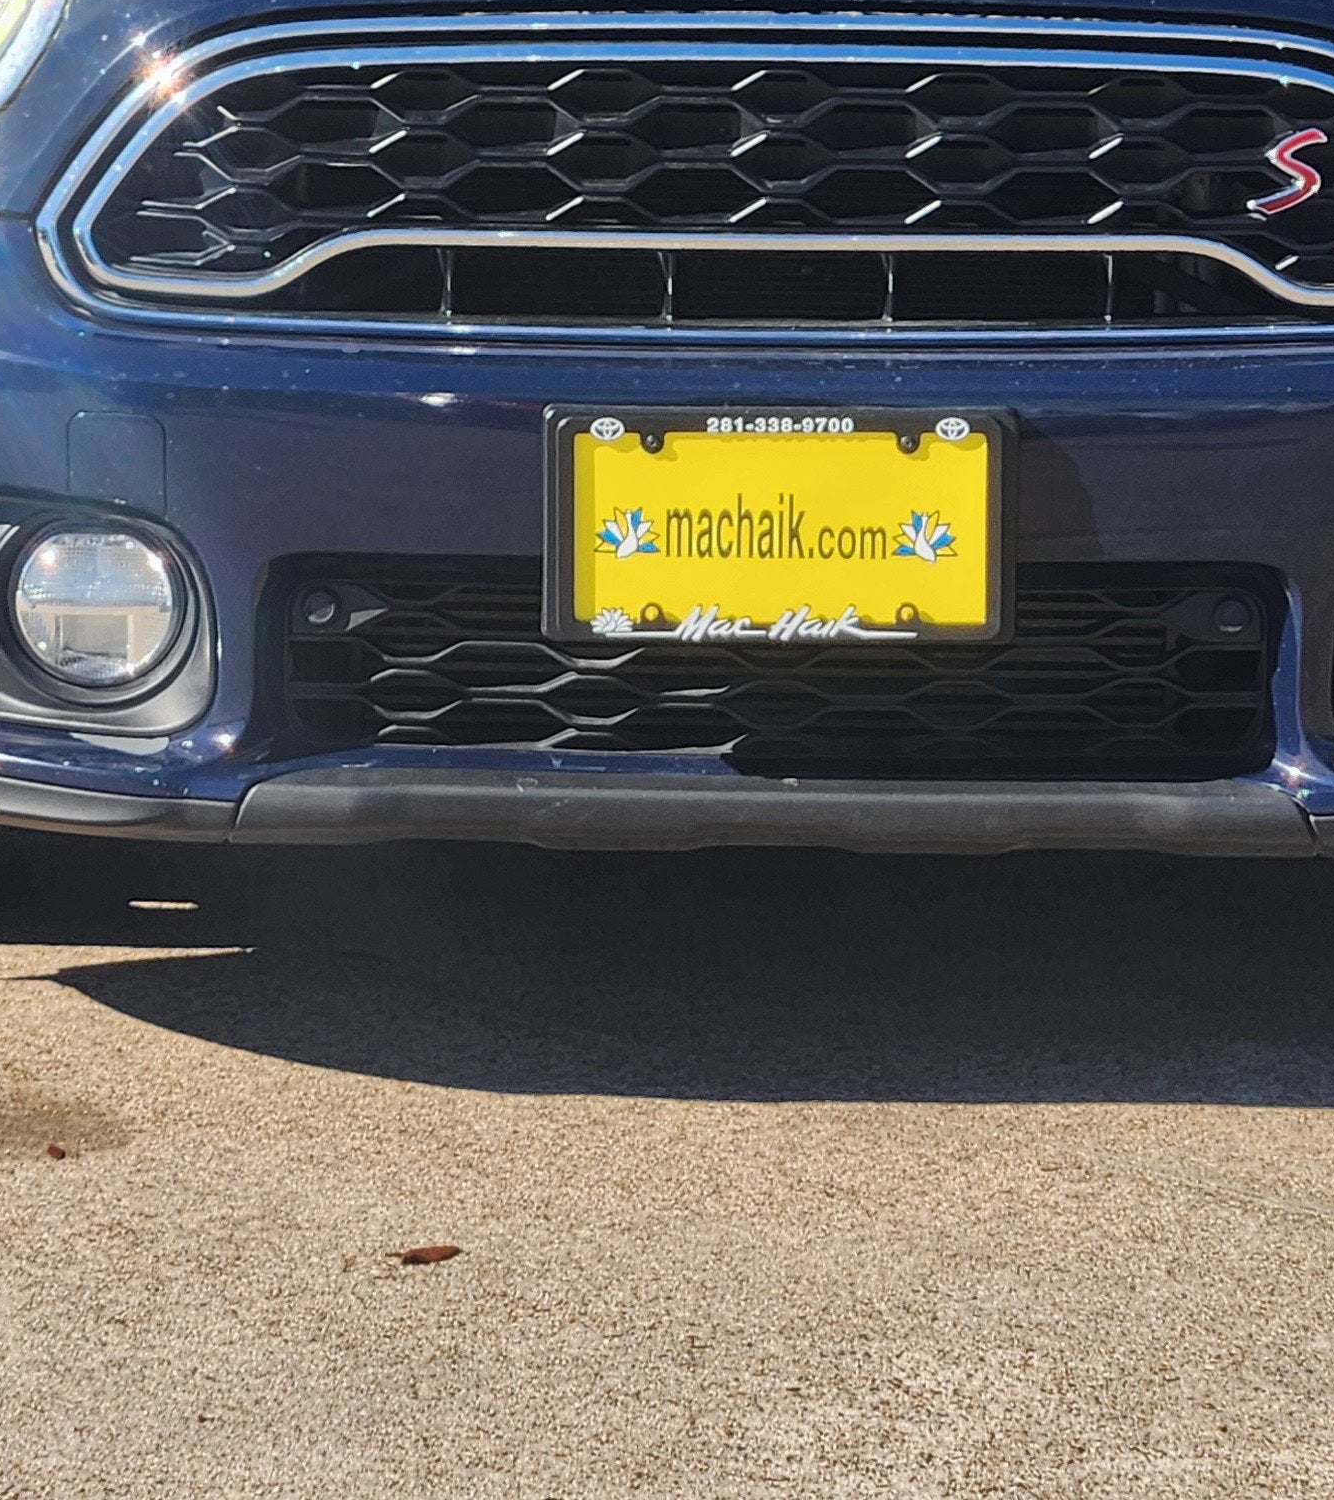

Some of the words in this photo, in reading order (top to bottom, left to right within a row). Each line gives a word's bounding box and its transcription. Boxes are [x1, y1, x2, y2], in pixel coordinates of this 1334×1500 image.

[1247, 127, 1328, 215] S
[706, 416, 855, 434] 281-338-9700
[666, 493, 887, 560] machaik.com
[673, 604, 753, 642] Mac
[767, 604, 859, 642] Haik
